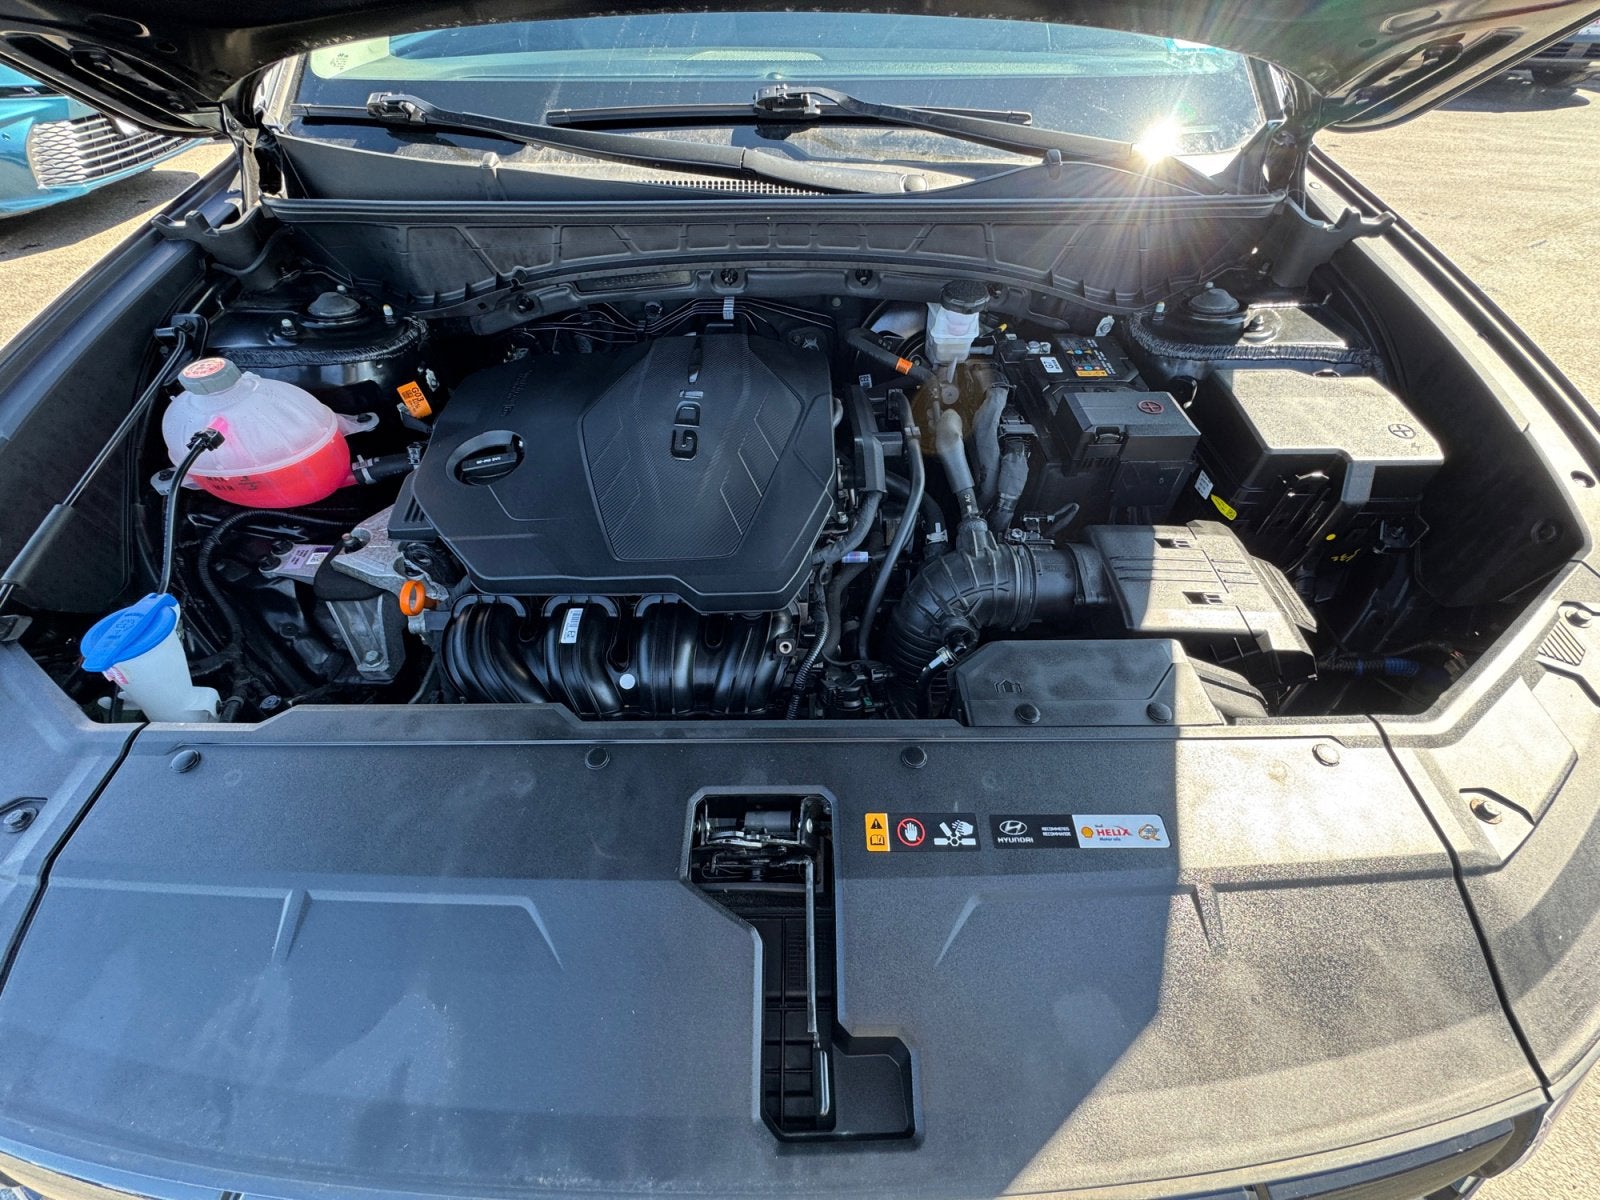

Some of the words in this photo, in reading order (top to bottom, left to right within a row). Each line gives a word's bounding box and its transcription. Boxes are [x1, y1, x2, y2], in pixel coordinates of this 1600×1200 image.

[411, 387, 425, 402] G03
[670, 390, 704, 461] GDi
[1096, 827, 1132, 837] HELIX
